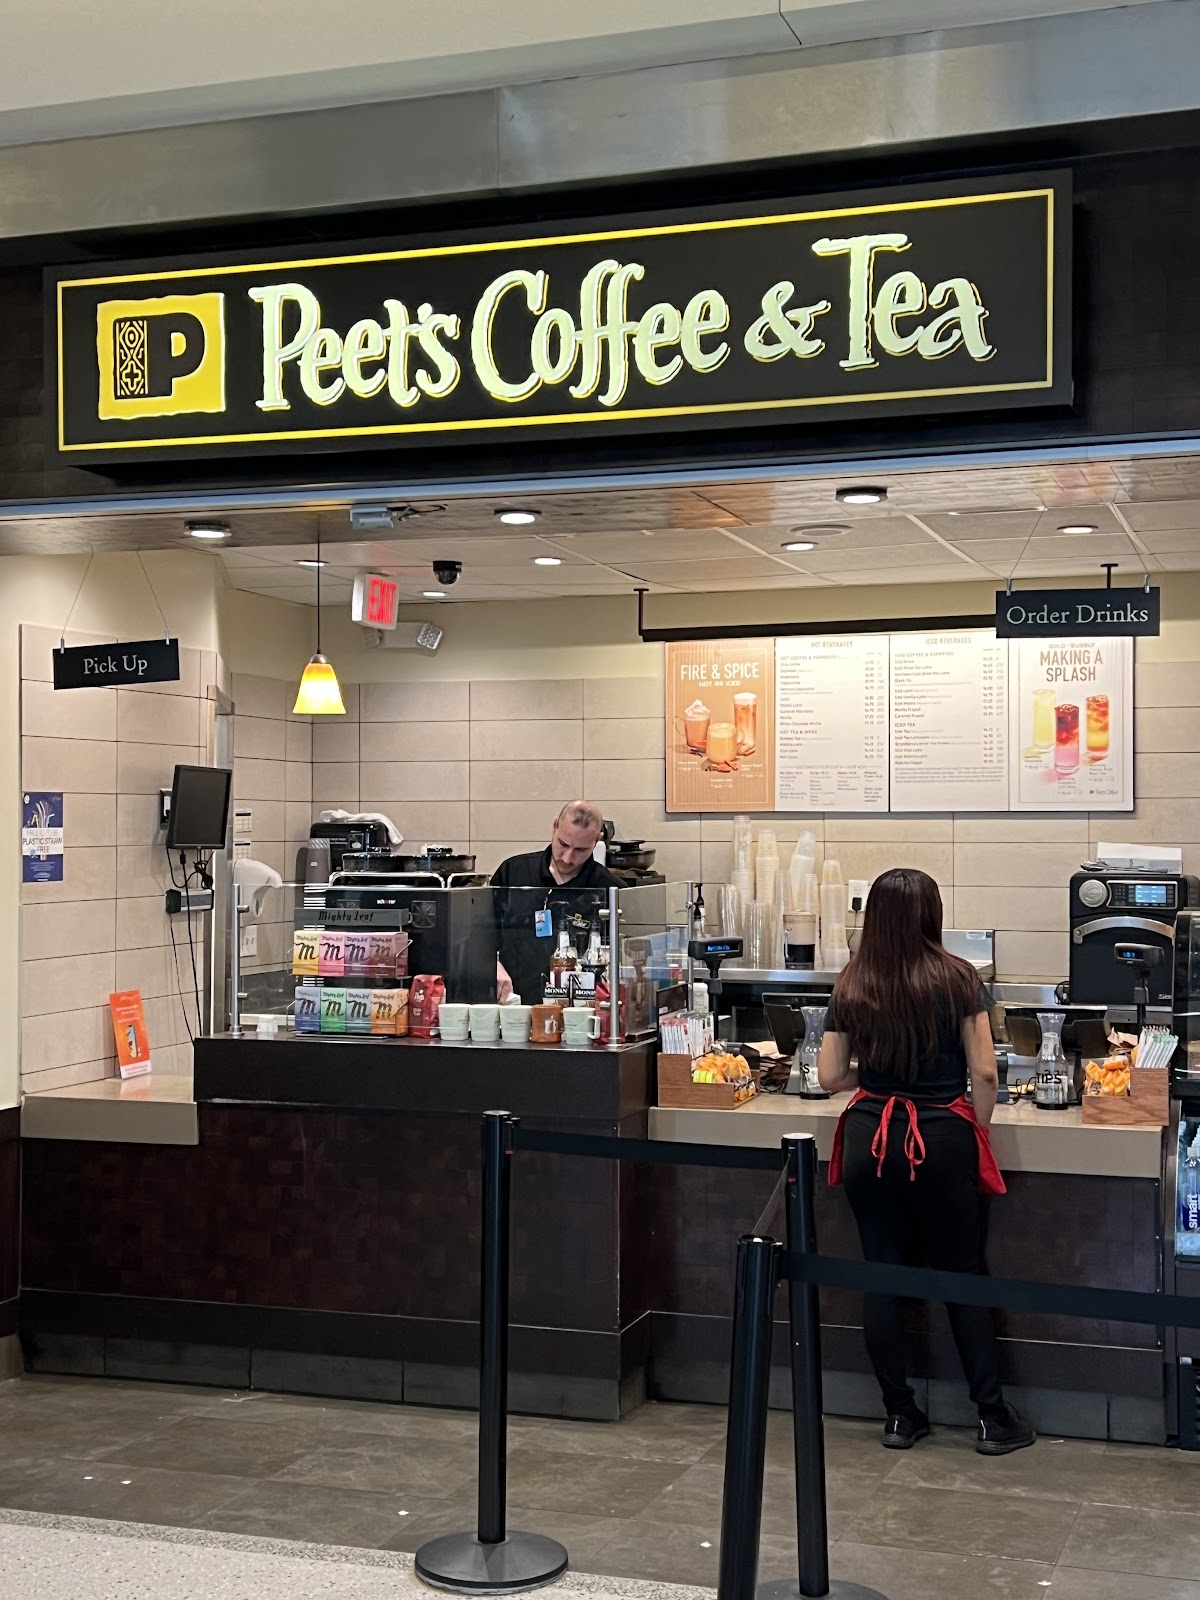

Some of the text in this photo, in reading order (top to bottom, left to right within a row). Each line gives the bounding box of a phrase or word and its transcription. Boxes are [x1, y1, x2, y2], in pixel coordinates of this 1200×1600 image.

[248, 233, 997, 411] Peet's Coffee & Tea
[367, 577, 397, 624] EXIT
[1006, 602, 1149, 625] Order Drinks
[83, 655, 148, 675] Pick Up
[1040, 649, 1103, 666] MAKING A
[681, 662, 760, 681] FIRE & SPICE
[1046, 666, 1096, 682] SPLASH
[22, 838, 44, 846] PLASTIC
[318, 910, 374, 923] Mighty Leaf
[544, 986, 568, 994] MONIN
[1036, 1072, 1062, 1084] TIPS
[1188, 1193, 1198, 1229] smart
